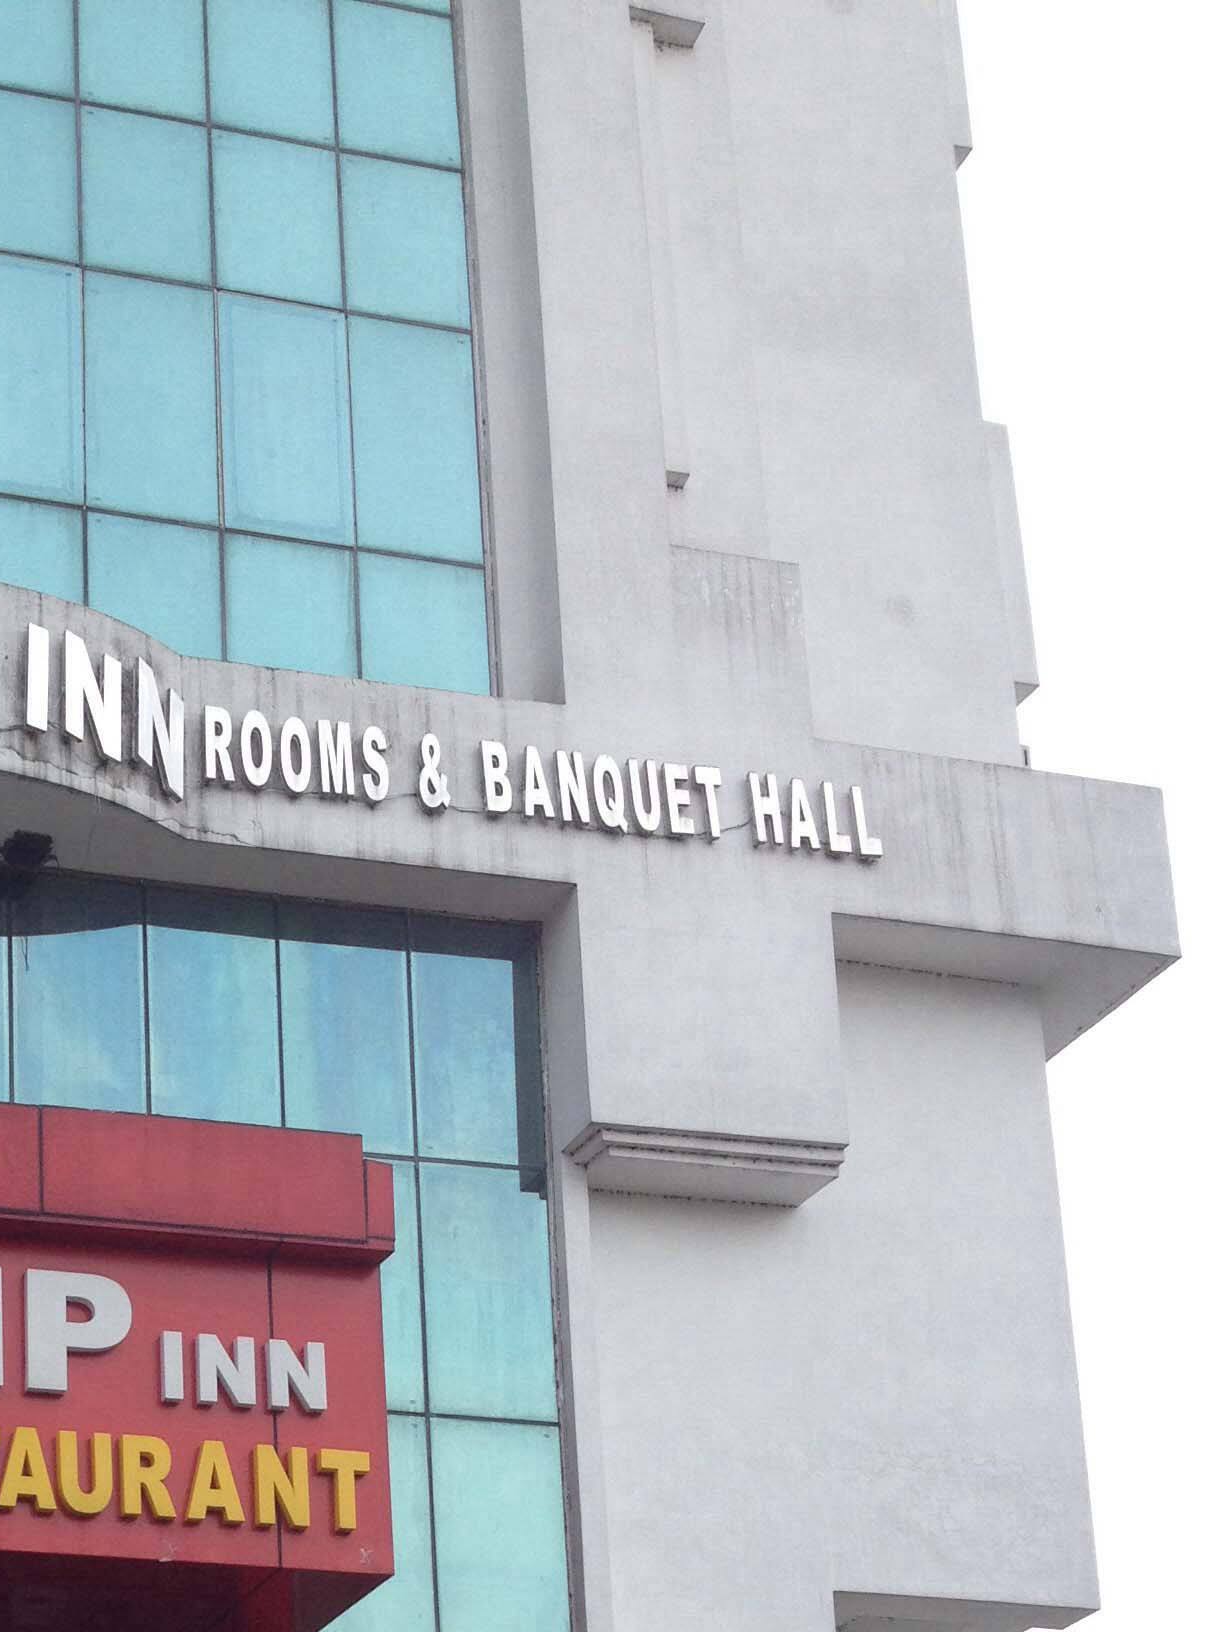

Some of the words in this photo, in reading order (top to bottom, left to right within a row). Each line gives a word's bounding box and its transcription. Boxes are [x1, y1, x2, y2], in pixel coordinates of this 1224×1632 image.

[25, 623, 184, 800] INN
[203, 705, 390, 801] ROOMS
[418, 733, 451, 810] &
[479, 740, 722, 841] BANQUET
[747, 771, 883, 860] HALL
[160, 1330, 327, 1412] INN
